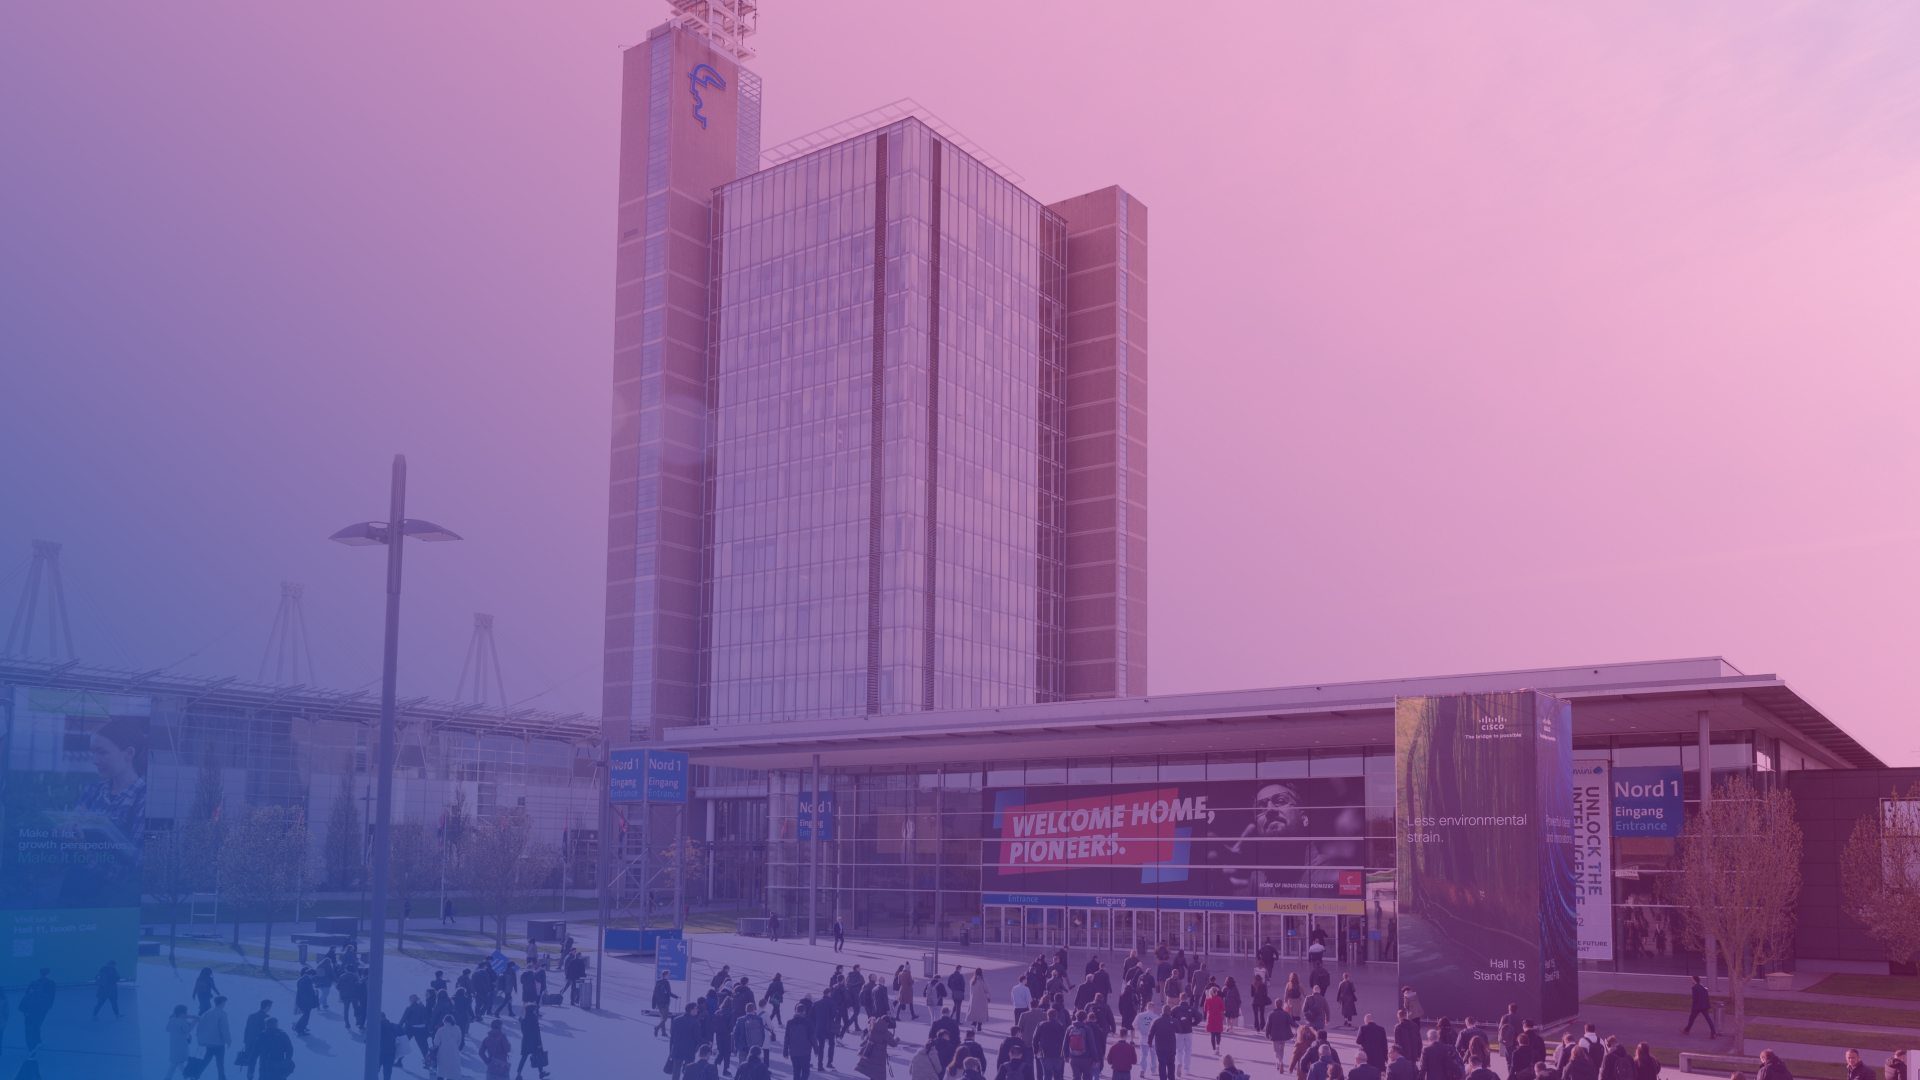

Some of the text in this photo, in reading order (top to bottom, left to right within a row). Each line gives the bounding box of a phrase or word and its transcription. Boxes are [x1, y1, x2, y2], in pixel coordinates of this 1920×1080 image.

[634, 758, 639, 769] 1
[649, 758, 681, 771] Nord 1
[610, 778, 637, 788] Eingang
[648, 777, 679, 789] Eingang
[1614, 779, 1665, 798] Nord
[1670, 780, 1679, 797] 1
[610, 789, 638, 798] Entrance
[648, 788, 680, 798] Entrance
[800, 800, 832, 813] Nod 1
[1012, 796, 1216, 838] WELCOME HOME,
[1615, 806, 1664, 819] Eingang
[1406, 813, 1527, 827] Less environmental
[1615, 820, 1668, 831] Entrance
[19, 829, 76, 838] Make it for
[1406, 831, 1444, 843] strain.
[18, 841, 130, 851] growth perspectives.
[1586, 787, 1603, 895] UNLOCK THE
[1010, 832, 1126, 864] PIONEERS.
[17, 851, 118, 863] Make it for life.
[1008, 894, 1039, 903] Entrance
[1095, 896, 1127, 907] Eingang
[1188, 898, 1224, 908] Entrance
[1273, 902, 1347, 911] Aussteller Exhibitor
[14, 915, 33, 924] Visit
[13, 923, 97, 934] Hall 11, booth C46
[1490, 958, 1525, 970] Hall 15
[1473, 970, 1526, 982] Stand F18
